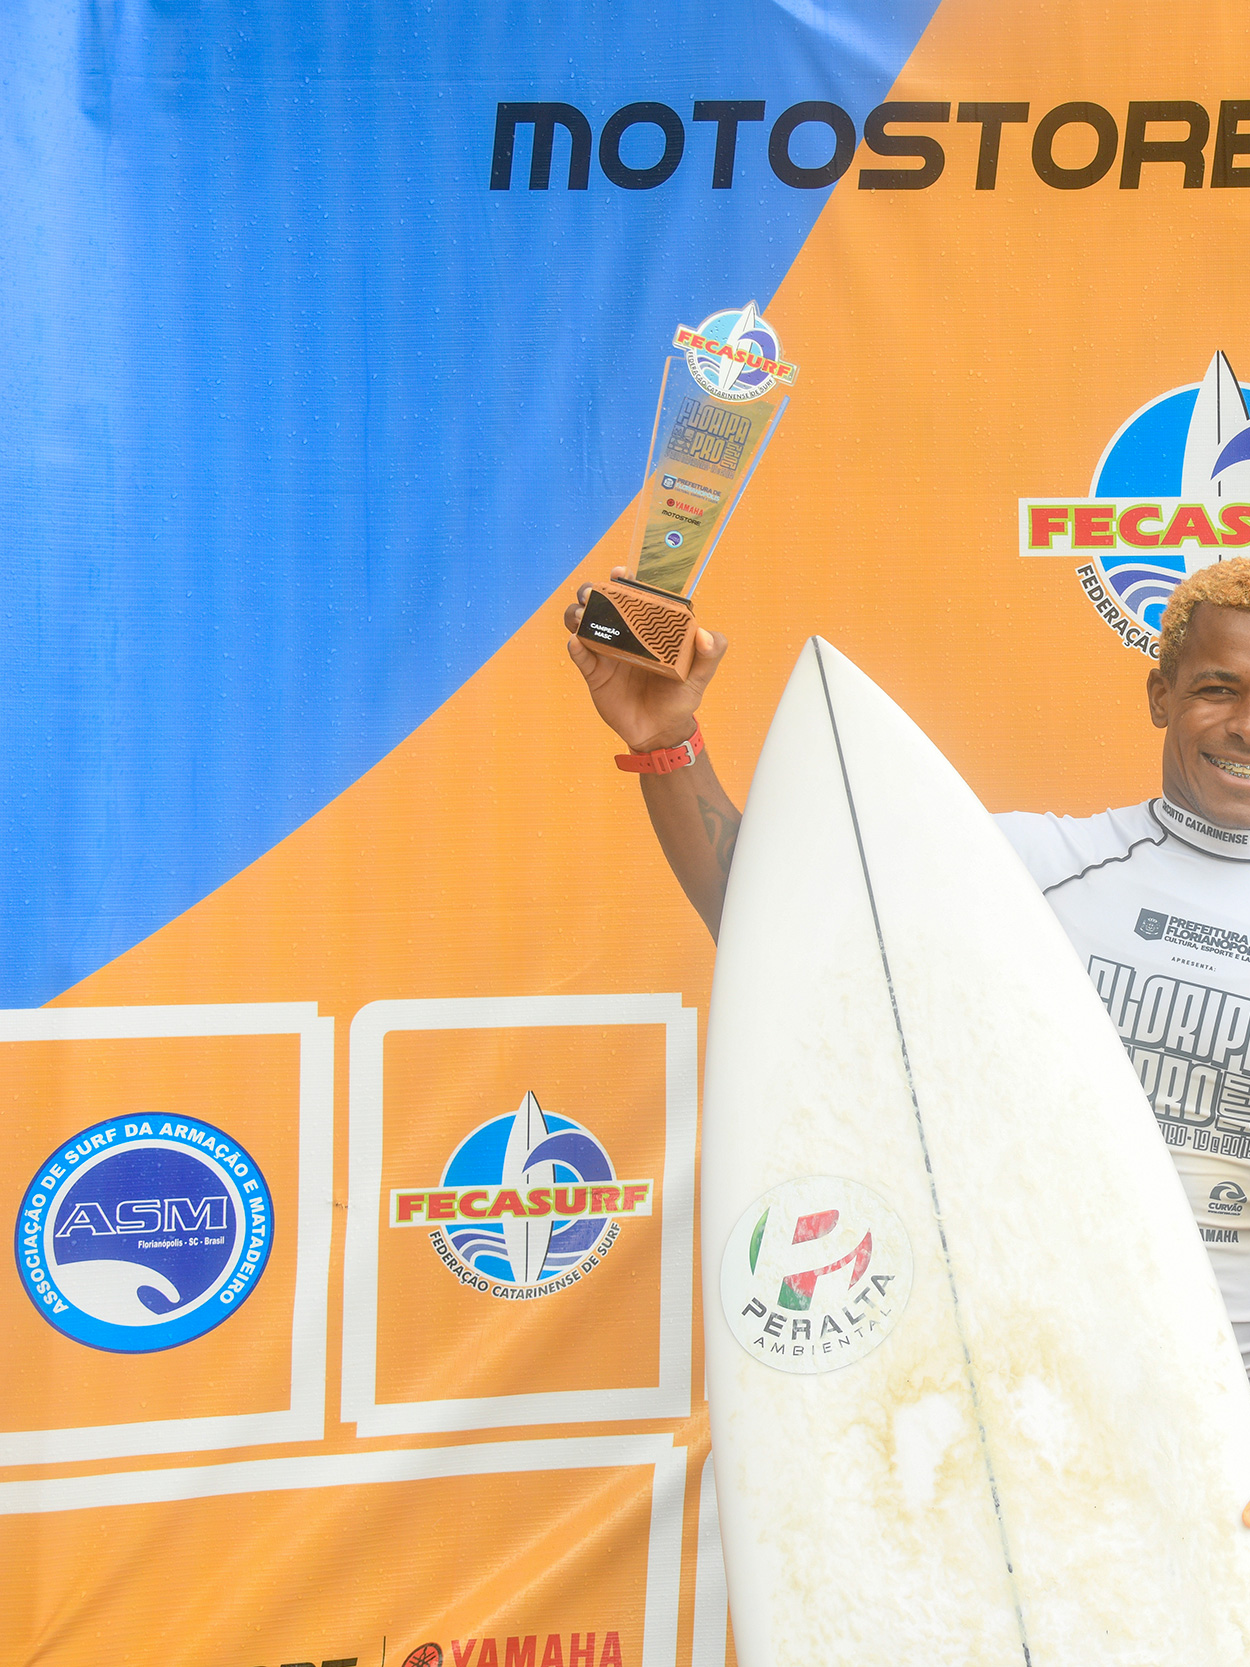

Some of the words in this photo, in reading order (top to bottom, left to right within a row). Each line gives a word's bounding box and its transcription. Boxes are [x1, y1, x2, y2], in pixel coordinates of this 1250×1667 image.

[676, 329, 792, 378] FECASURF
[707, 385, 749, 400] CATARINENSE
[677, 397, 752, 445] FLORIPA
[690, 431, 726, 464] PRO
[662, 510, 701, 526] MOTOSTORE
[675, 501, 704, 517] YAMAHA
[1185, 816, 1248, 845] CATARINENSE
[1164, 935, 1199, 950] CULTURA,
[1200, 945, 1234, 958] ESPORTE
[1168, 915, 1249, 945] PREFEITURA
[64, 1128, 117, 1165] SURF
[124, 1122, 153, 1138] DA
[1193, 1129, 1211, 1151] 19
[159, 1122, 249, 1178] ARMAÇÃO
[40, 1163, 66, 1190] DE
[243, 1179, 259, 1194] E
[55, 1195, 228, 1238] ASM
[396, 1183, 650, 1223] FECASURF
[1208, 1202, 1243, 1212] CURVÃO
[23, 1194, 70, 1315] ASSOCIAÇÃO
[137, 1238, 183, 1250] Florianópolis
[188, 1237, 199, 1247] SC
[204, 1236, 225, 1246] Brasil
[219, 1196, 266, 1305] MATADEIRO
[429, 1230, 489, 1292] FEDERAÇÃO
[491, 1269, 581, 1300] CATARINENSE
[581, 1255, 599, 1273] DE
[598, 1222, 621, 1258] SURF
[741, 1275, 896, 1340] PERALTA
[753, 1308, 892, 1356] AMBIENTAL
[450, 1631, 623, 1667] YAMAHA
